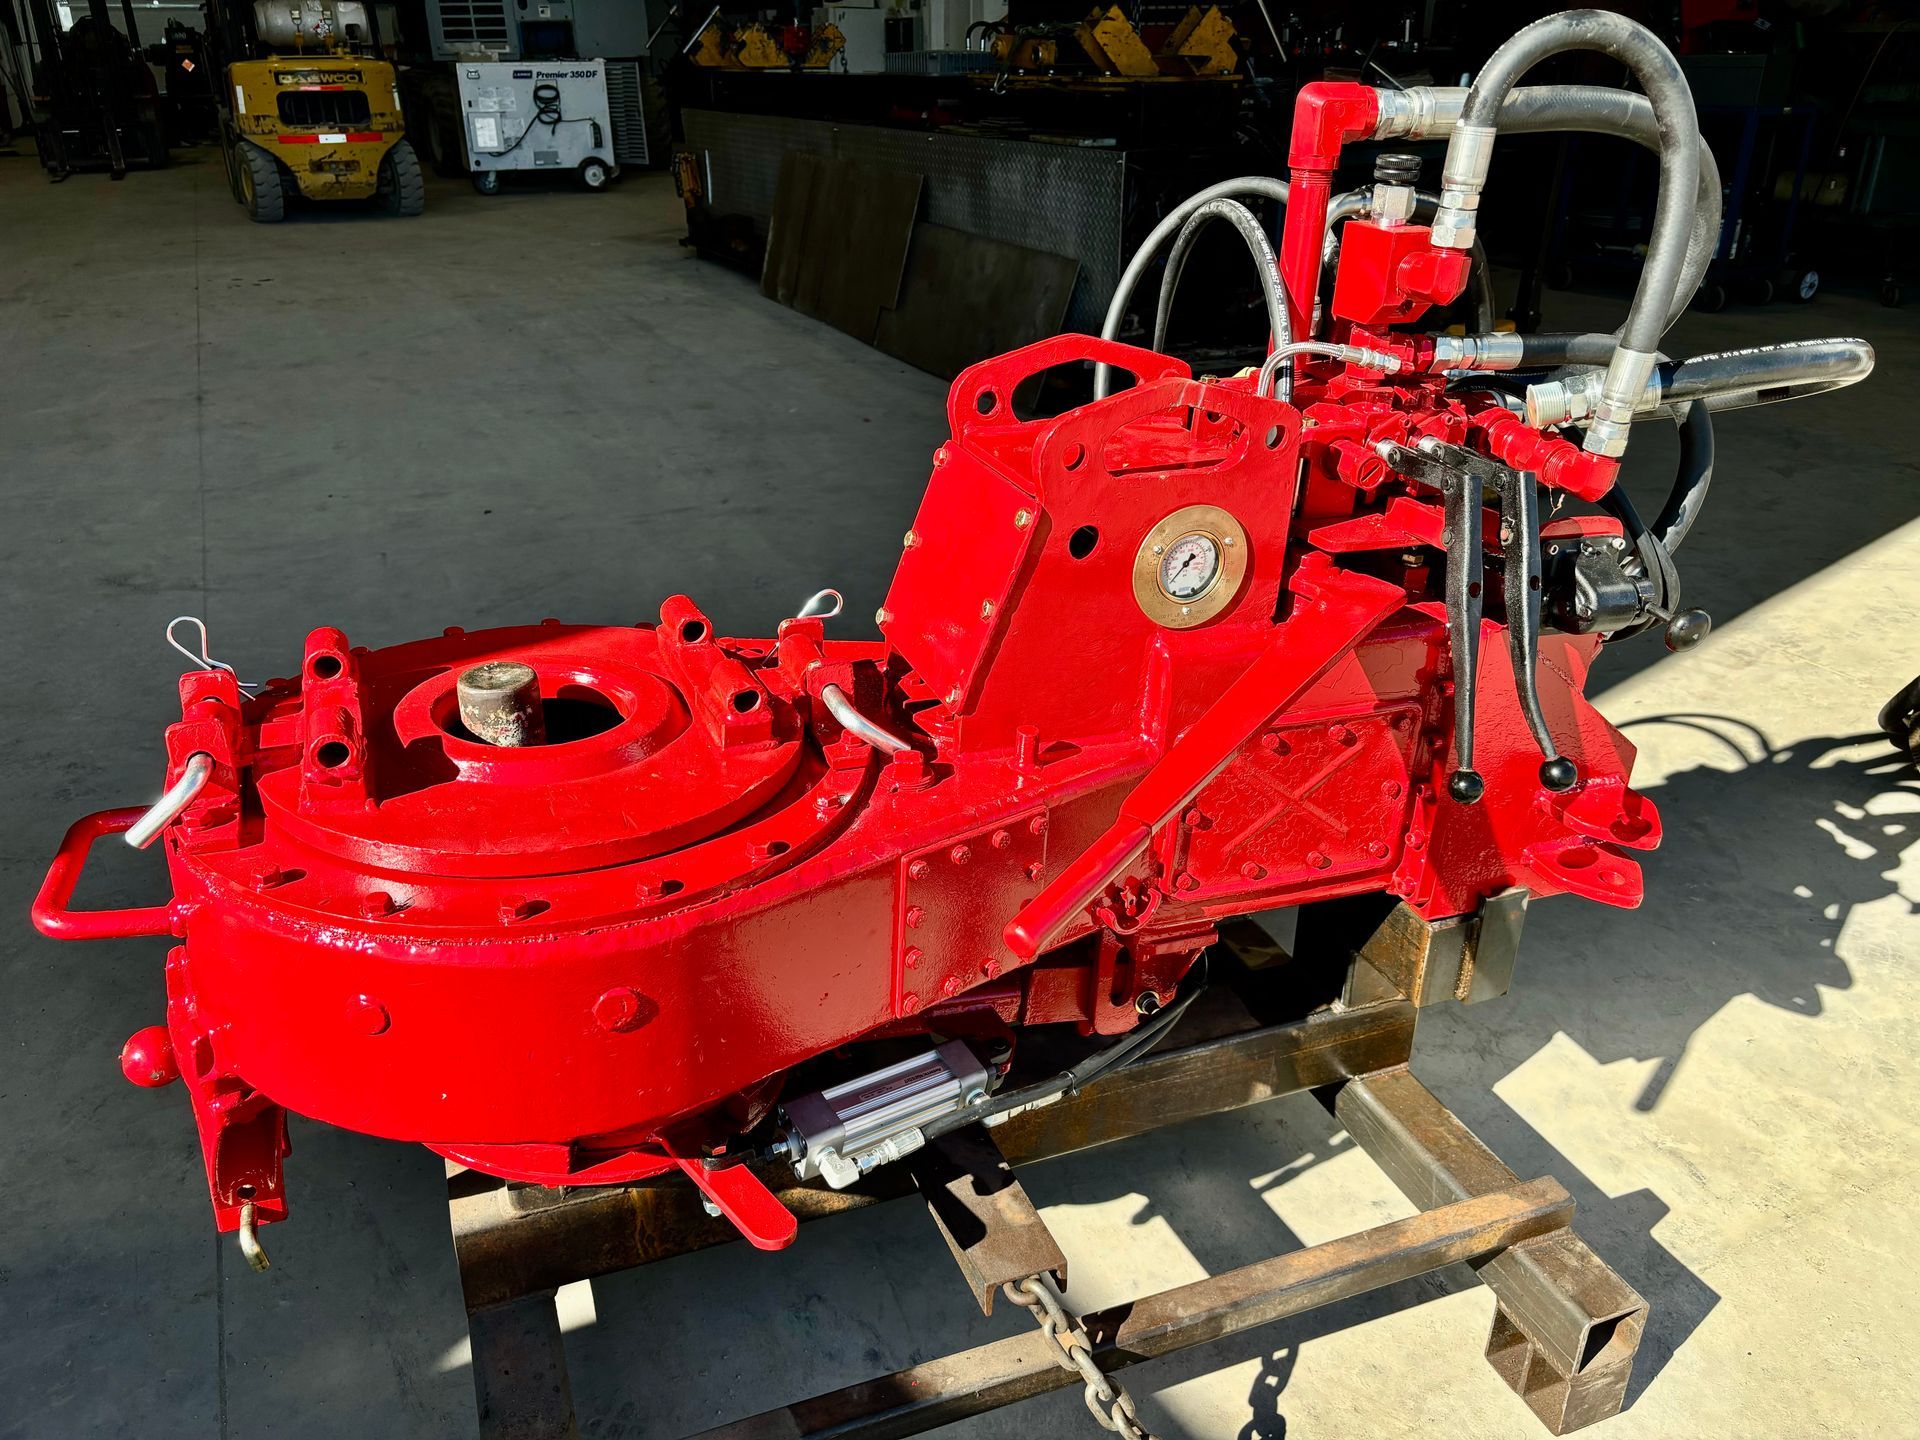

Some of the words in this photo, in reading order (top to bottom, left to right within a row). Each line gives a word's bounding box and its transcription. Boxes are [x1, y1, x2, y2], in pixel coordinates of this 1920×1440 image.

[536, 70, 569, 79] Premier
[1269, 263, 1280, 283] EN857
[1274, 284, 1283, 299] 2SC
[1278, 304, 1288, 327] MSHA
